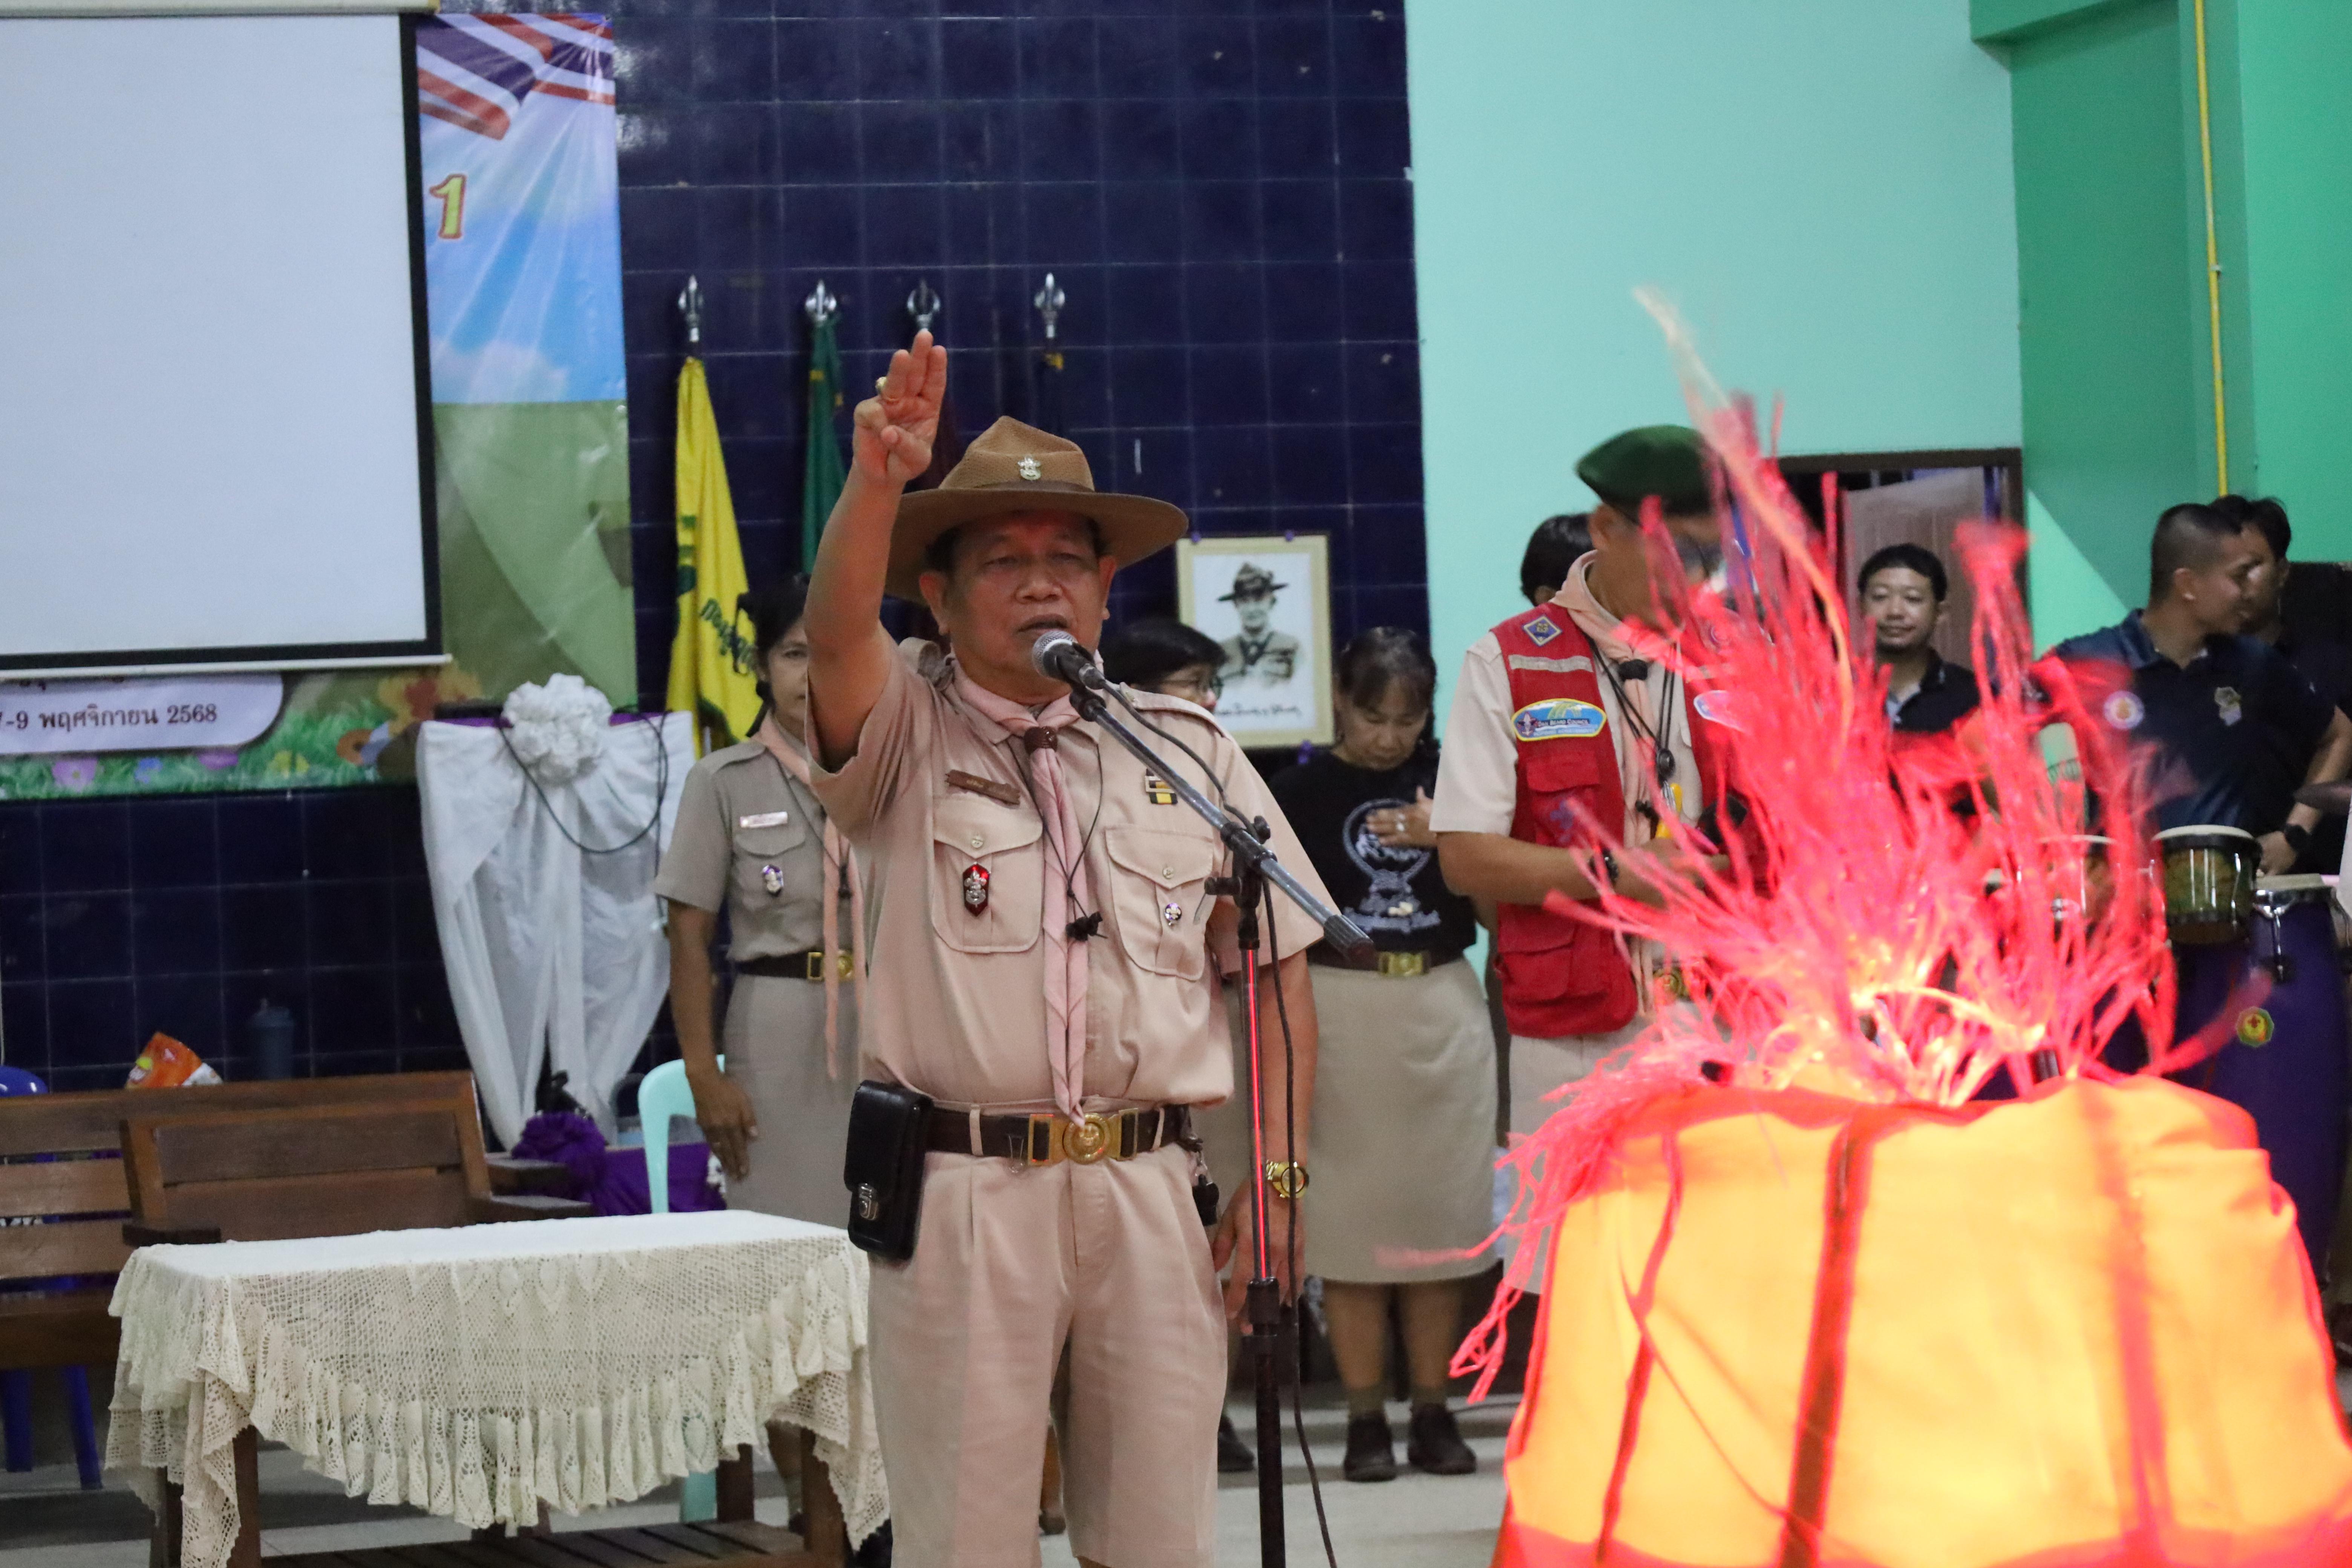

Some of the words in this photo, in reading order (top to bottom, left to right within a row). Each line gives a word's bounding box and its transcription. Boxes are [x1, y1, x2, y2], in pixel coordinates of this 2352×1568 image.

[429, 173, 466, 239] 1
[0, 710, 29, 729] -9
[39, 703, 158, 732] พฤศจิกายน
[167, 703, 217, 724] 2568
